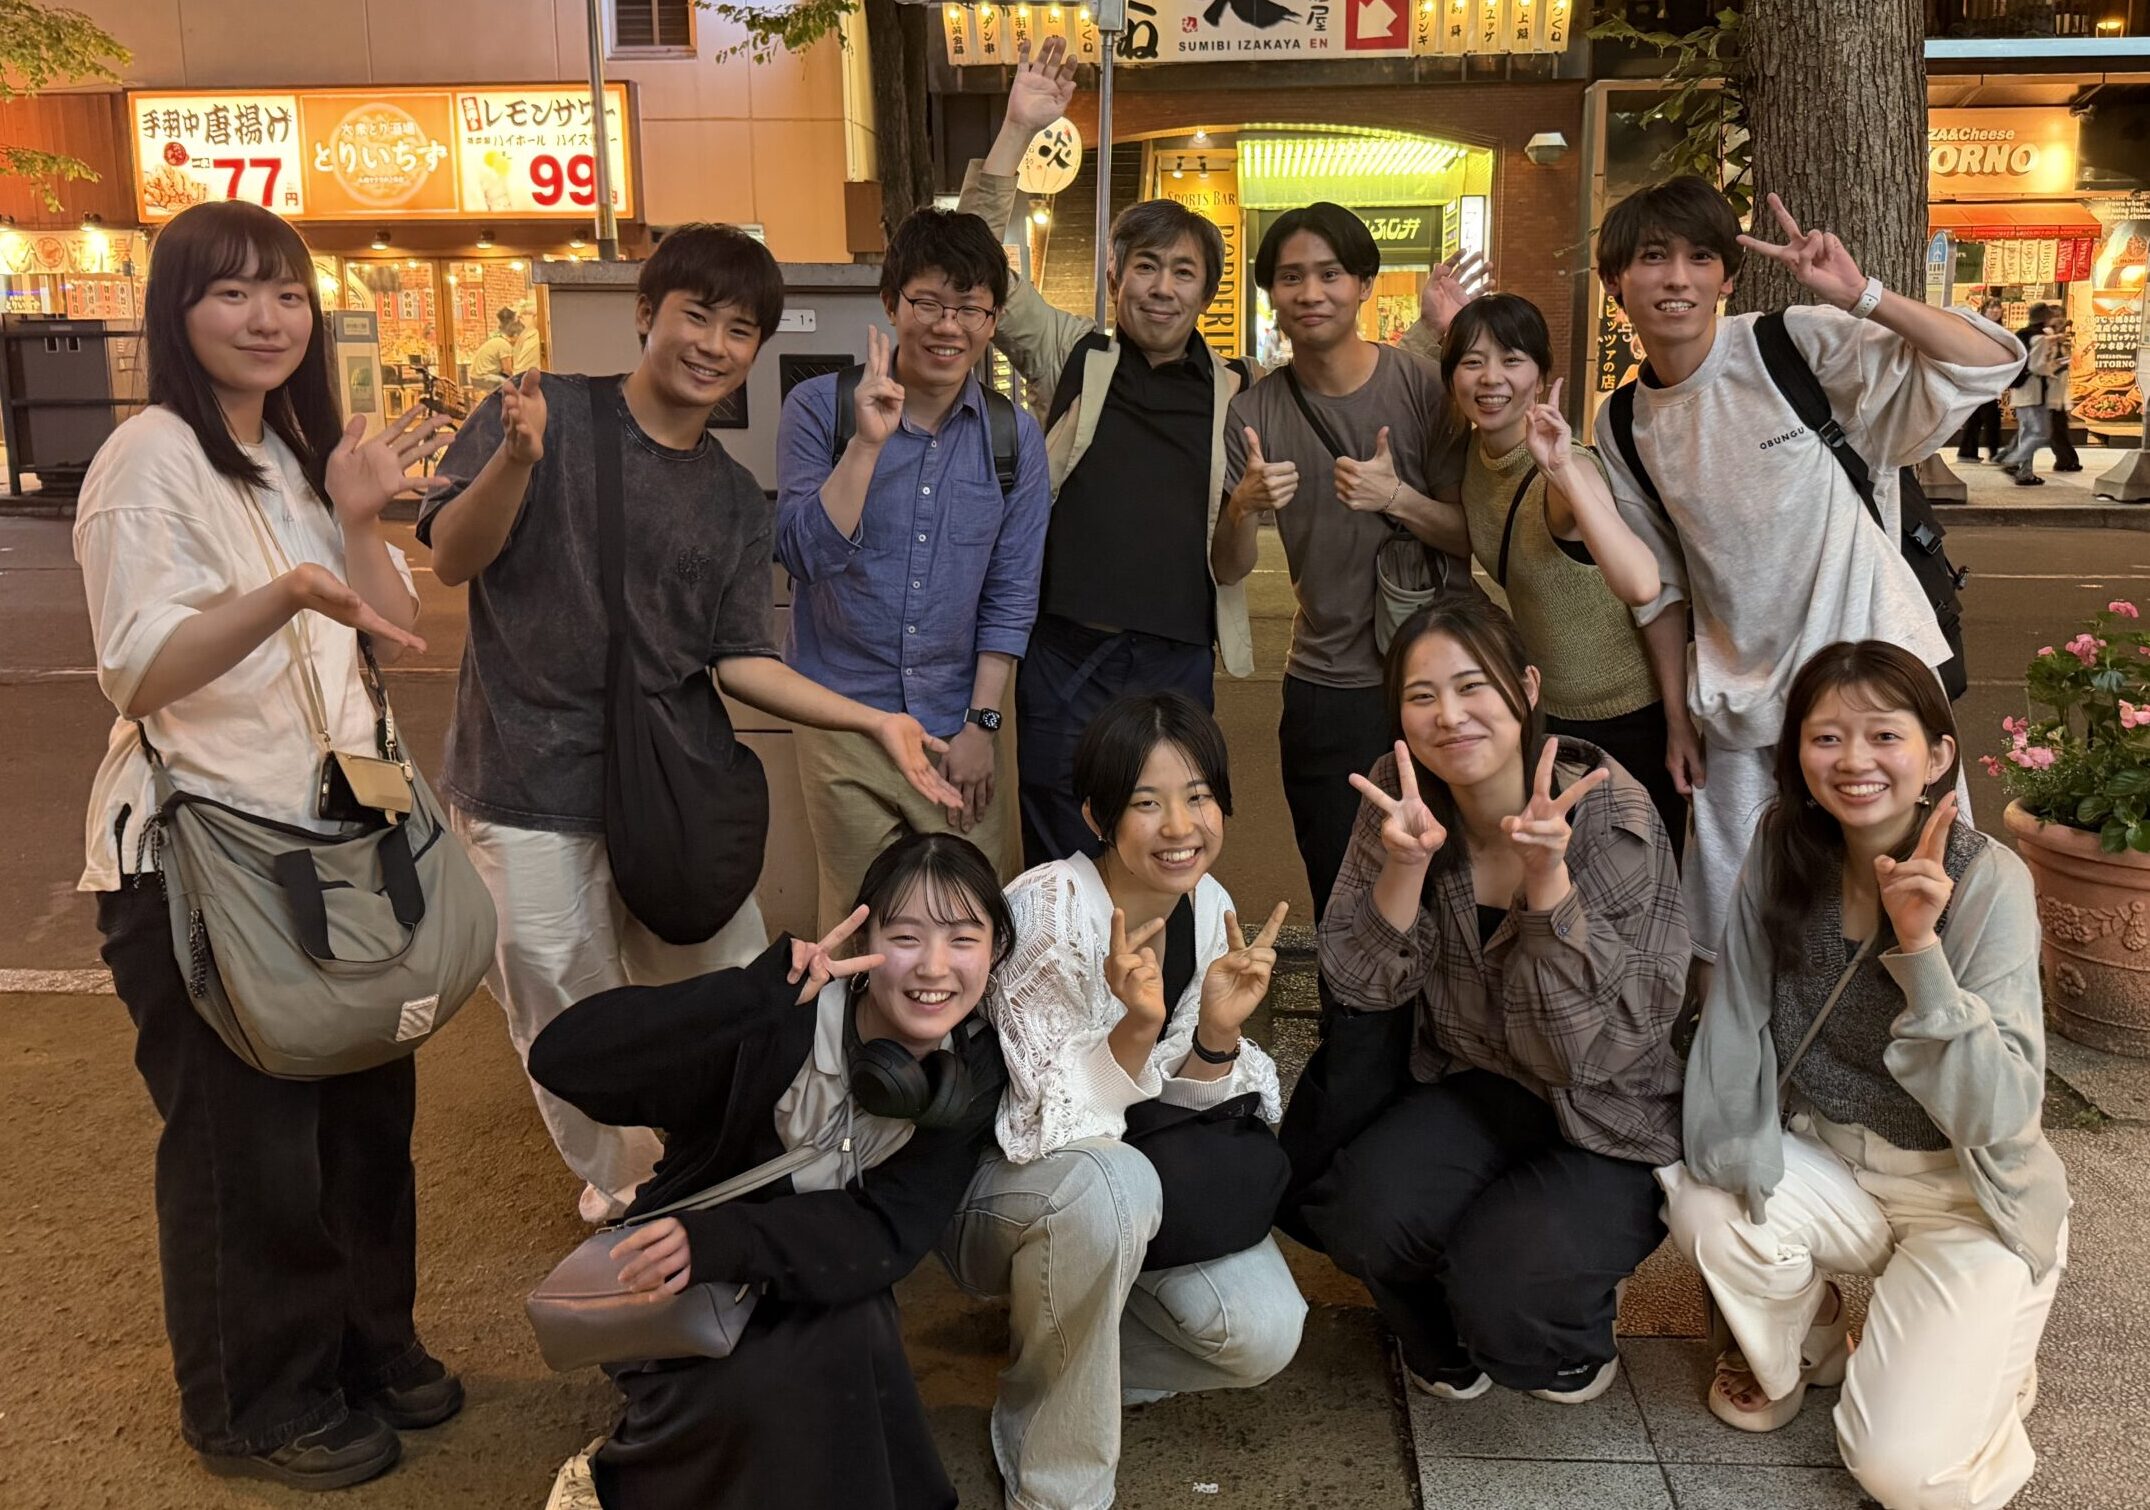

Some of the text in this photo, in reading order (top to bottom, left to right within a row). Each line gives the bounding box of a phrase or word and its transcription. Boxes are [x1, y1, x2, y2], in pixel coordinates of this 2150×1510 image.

[1484, 2, 1496, 42] ユッケ
[1178, 38, 1329, 52] SUMIBI IZAKAYA EN
[142, 103, 292, 146] 手羽中唐揚げ
[313, 139, 449, 174] とりいちず
[1928, 142, 2041, 176] ORNO
[213, 157, 281, 207] 77
[529, 153, 597, 206] 99
[1213, 190, 1236, 206] BAR
[1759, 426, 1805, 450] OBUNGU
